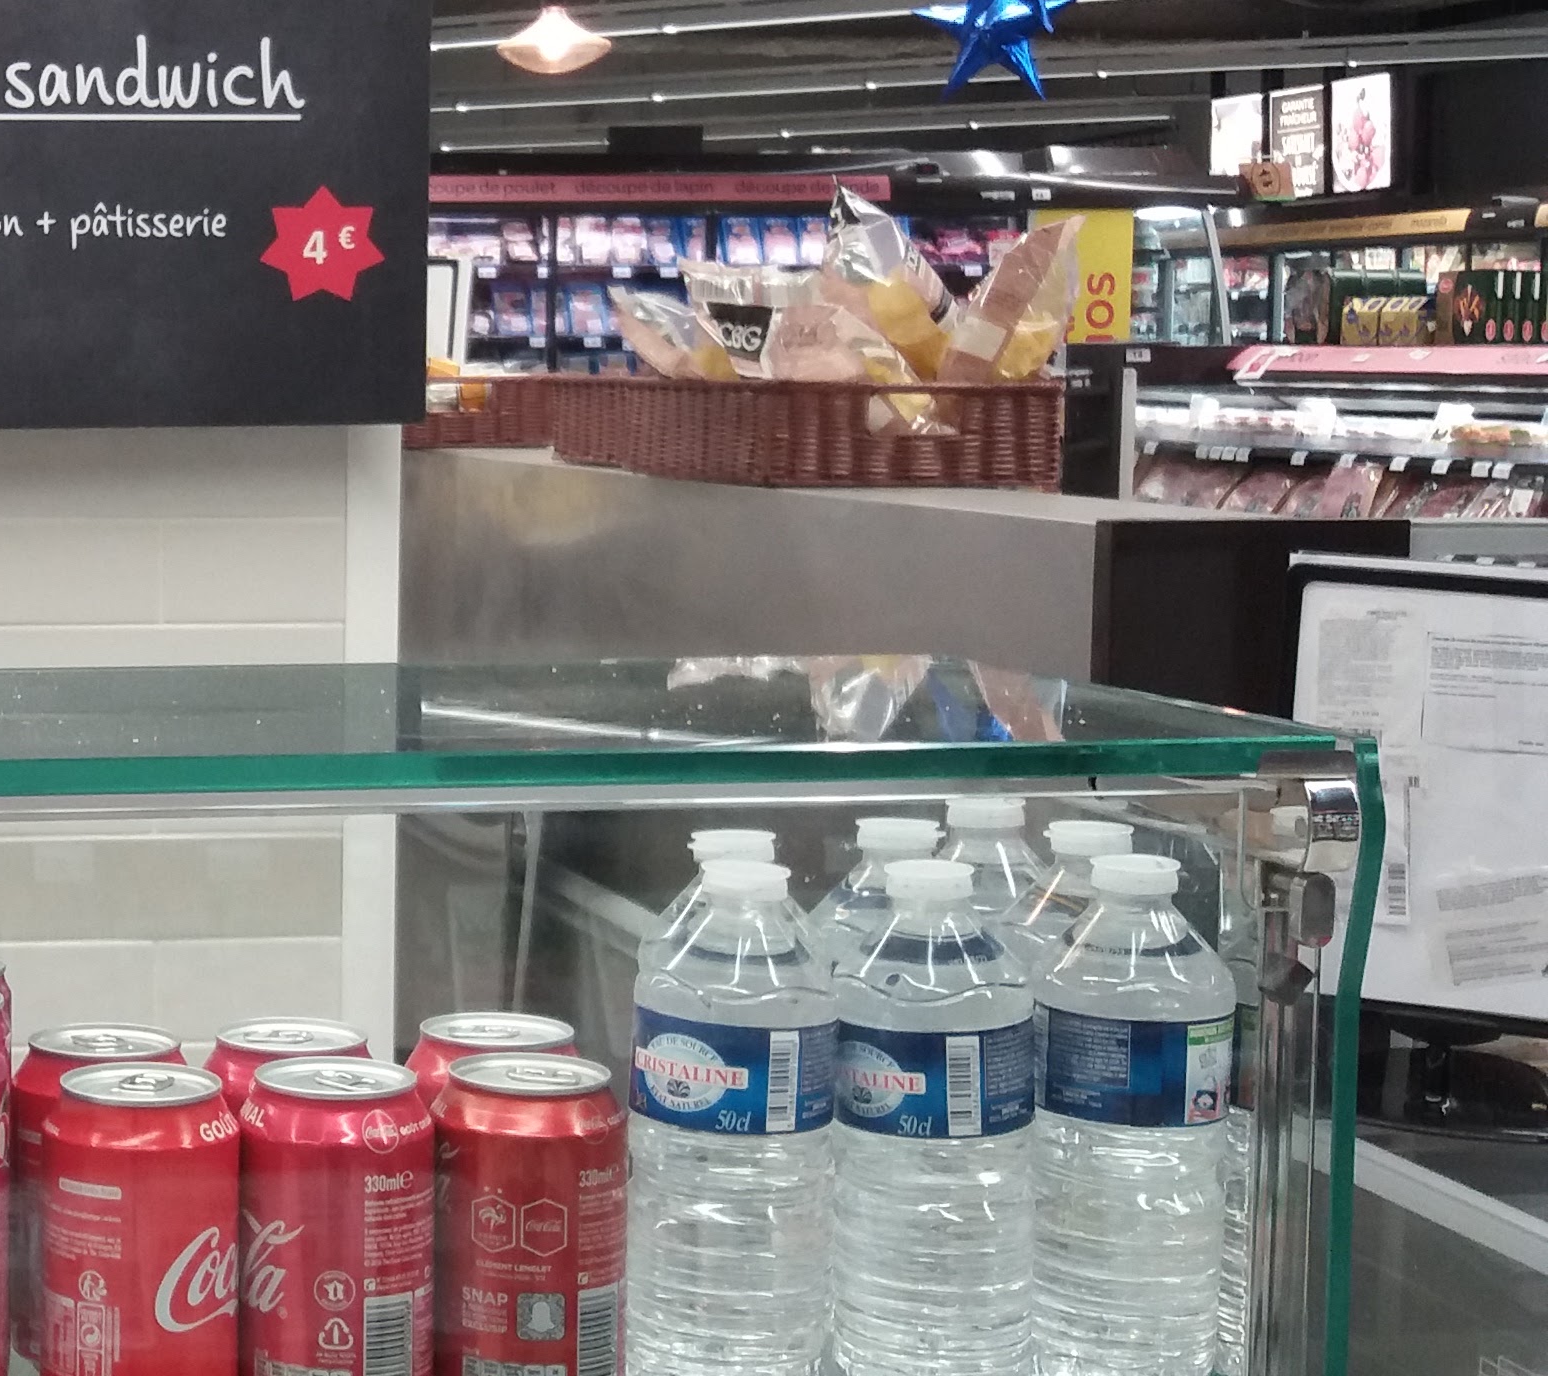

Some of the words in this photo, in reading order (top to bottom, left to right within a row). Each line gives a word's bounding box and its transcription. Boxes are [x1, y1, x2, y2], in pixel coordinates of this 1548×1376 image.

[4, 34, 305, 111] sandwich
[70, 202, 226, 250] pâtisserie
[636, 1050, 745, 1088] CRISTALINE
[462, 1285, 509, 1307] SNAP
